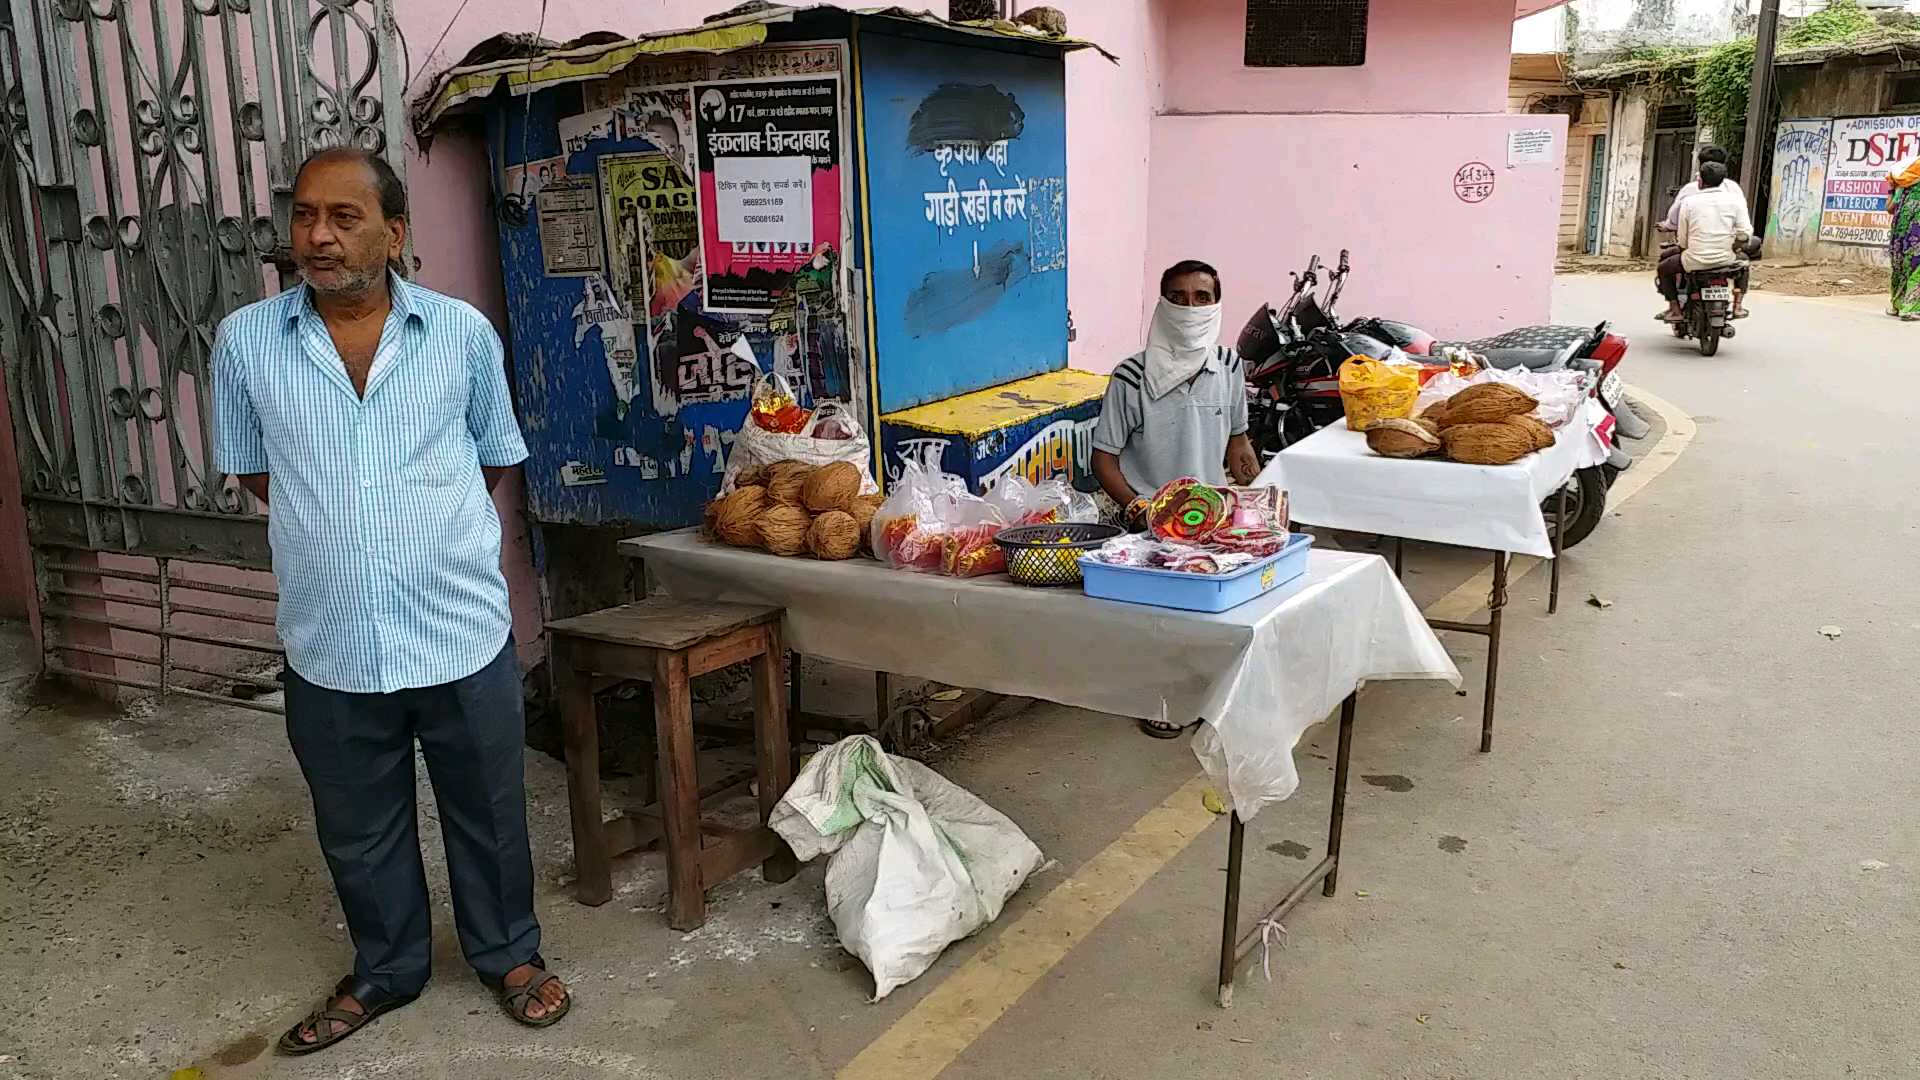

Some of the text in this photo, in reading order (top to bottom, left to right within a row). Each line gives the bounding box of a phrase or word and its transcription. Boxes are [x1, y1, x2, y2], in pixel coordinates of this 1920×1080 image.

[729, 104, 745, 122] 17
[1850, 117, 1904, 130] ADMISSION
[1834, 181, 1881, 193] FASHION
[924, 178, 960, 235] गाड़ी
[961, 178, 991, 231] खड़ी
[992, 189, 1002, 221] न
[1002, 174, 1027, 220] करें
[1832, 196, 1879, 209] INTERIOR
[1830, 212, 1865, 224] EVENT
